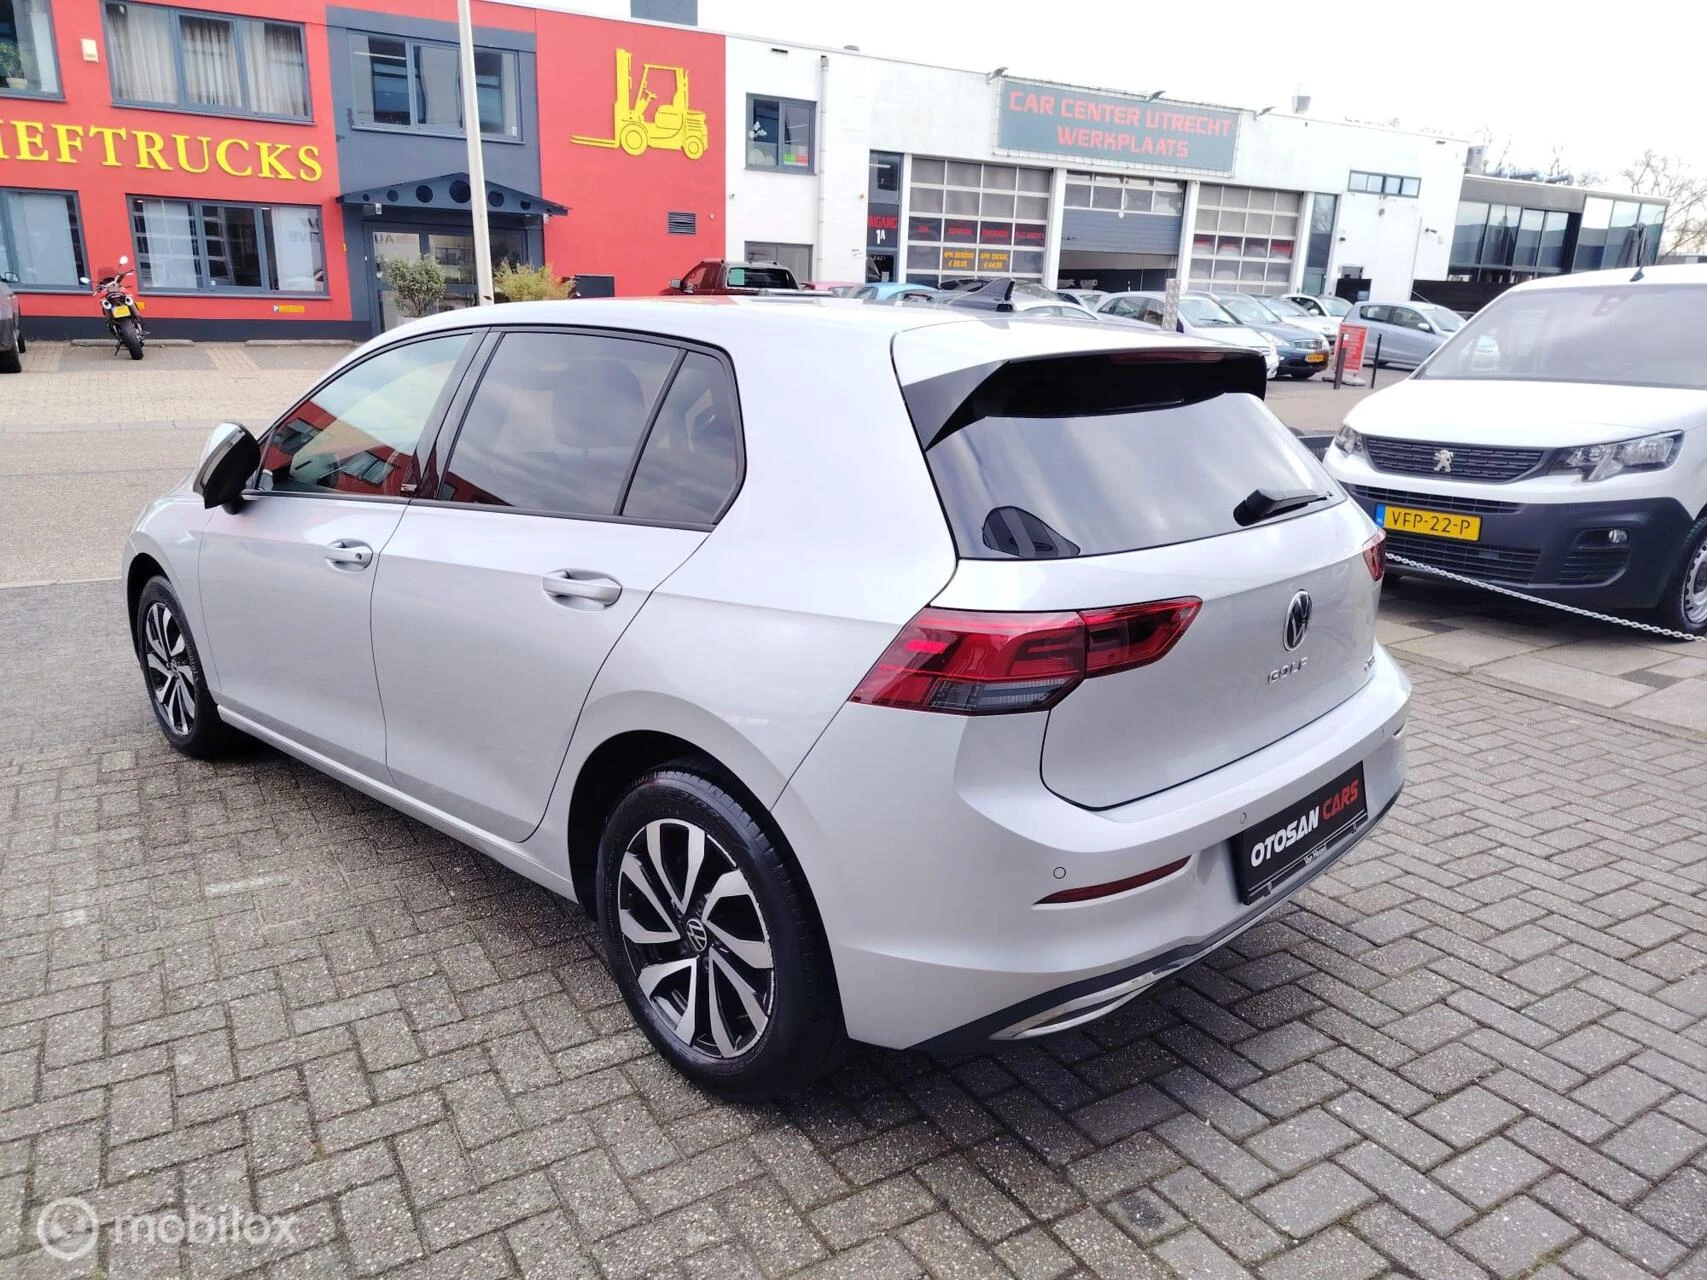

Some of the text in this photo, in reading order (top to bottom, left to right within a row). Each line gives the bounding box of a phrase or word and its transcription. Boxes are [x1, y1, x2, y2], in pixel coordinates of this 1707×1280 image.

[1009, 91, 1232, 137] CAR CENTER UTRECHT
[0, 119, 322, 182] EFTRUCKS
[1057, 126, 1189, 158] WERKPLAATS
[1392, 511, 1471, 535] VFP-22-P
[1267, 657, 1308, 685] GOLF
[1250, 778, 1359, 868] OTOSAN CARS
